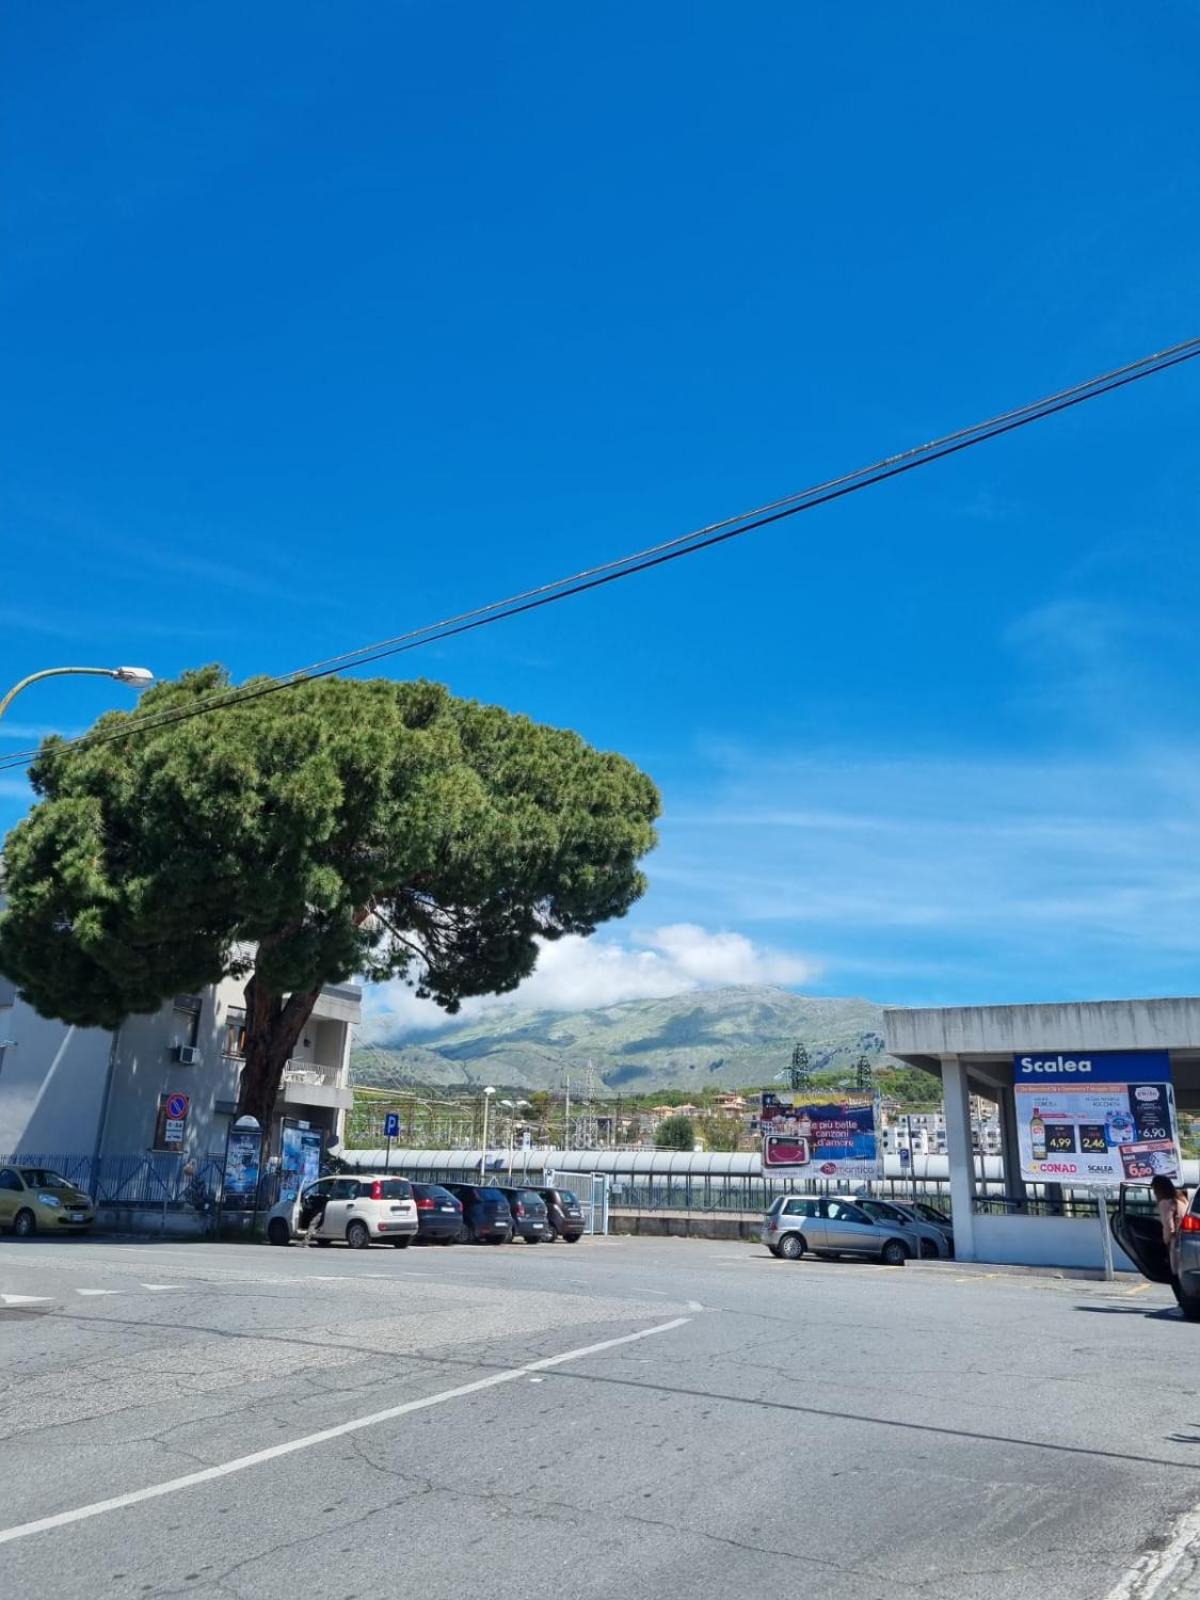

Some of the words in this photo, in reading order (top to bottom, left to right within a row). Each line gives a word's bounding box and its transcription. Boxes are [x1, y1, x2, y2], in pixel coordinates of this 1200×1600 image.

[1021, 1056, 1092, 1073] Scalea
[815, 1129, 849, 1138] canzoni
[1143, 1128, 1166, 1139] 6,90
[1049, 1138, 1072, 1148] 4,99
[1082, 1138, 1105, 1148] 2,46
[1040, 1163, 1077, 1173] CONAD
